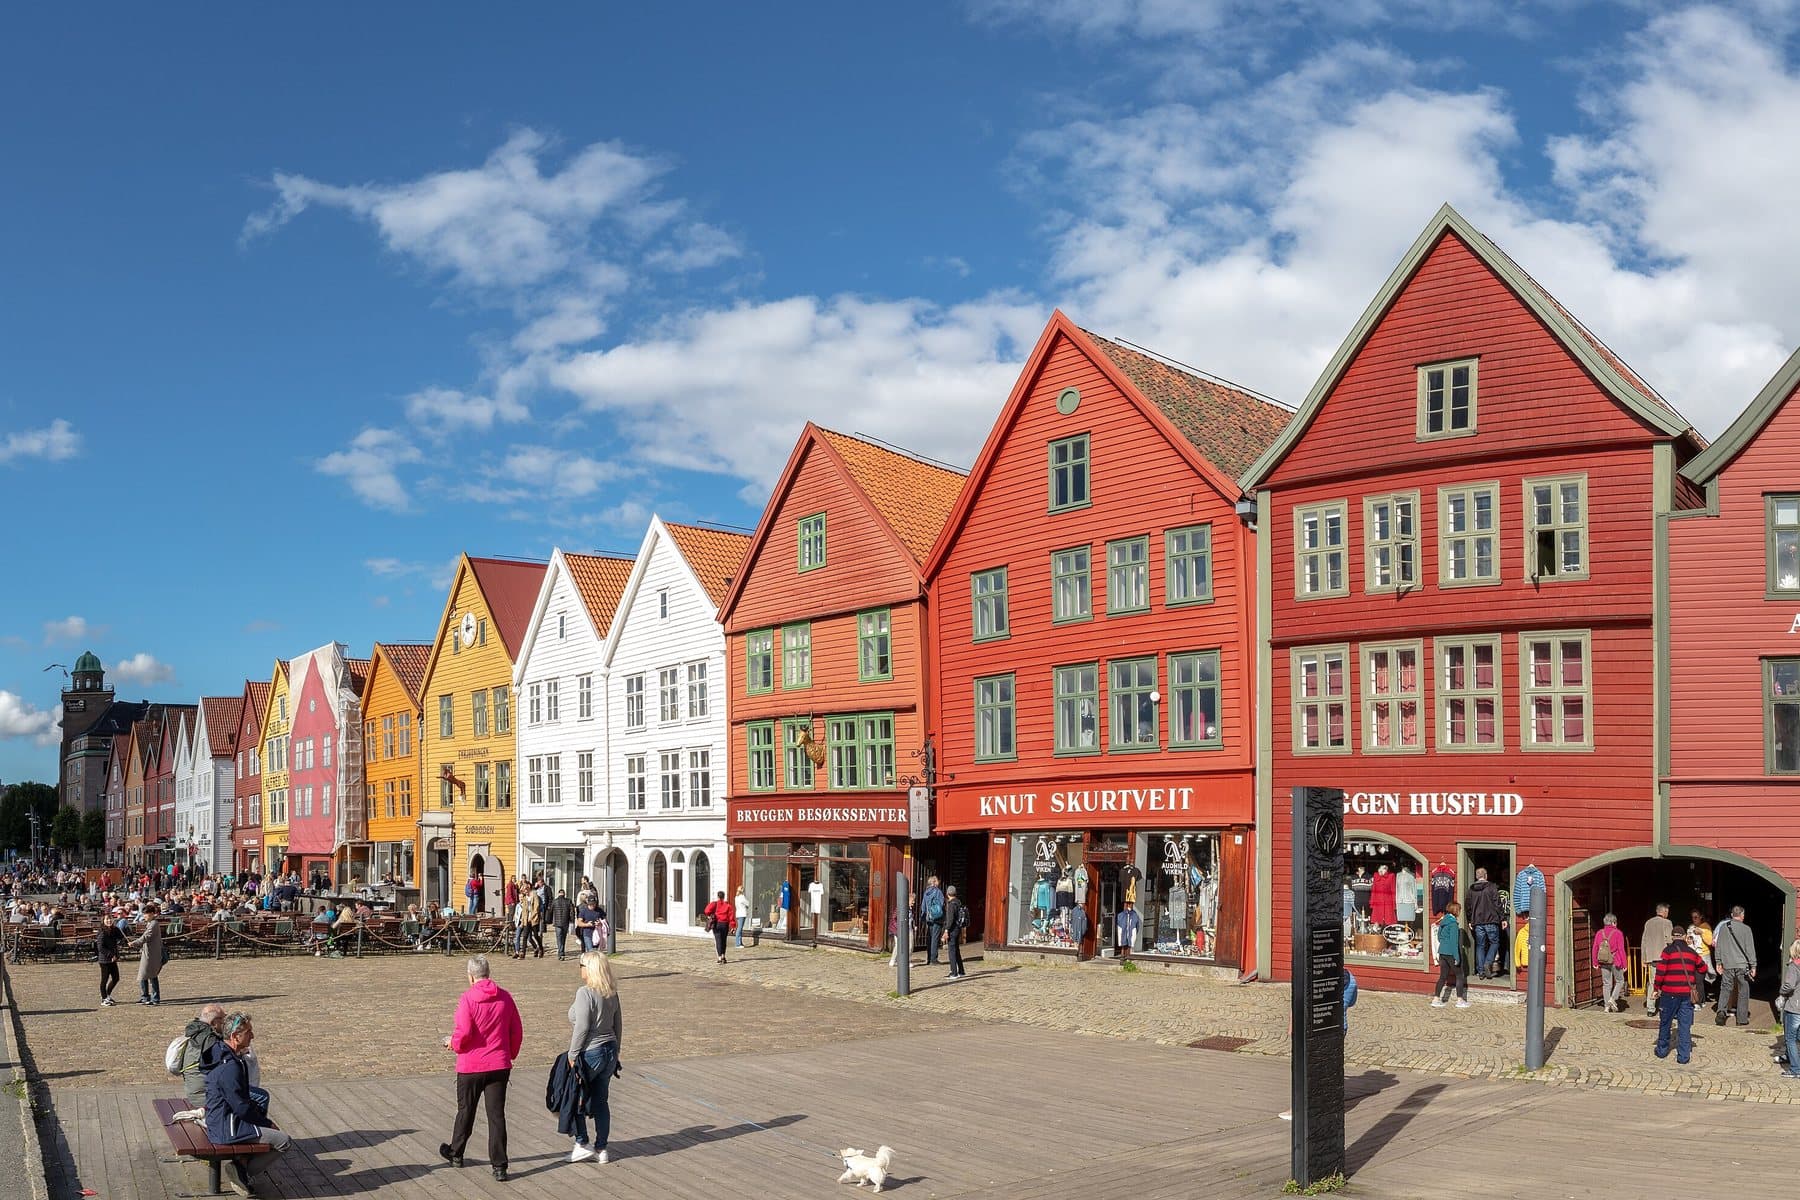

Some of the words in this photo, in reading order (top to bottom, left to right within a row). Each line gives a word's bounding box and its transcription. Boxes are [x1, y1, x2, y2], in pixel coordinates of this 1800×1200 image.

[979, 794, 1037, 816] KNUT
[1050, 788, 1193, 813] SKURTVEIT
[1409, 792, 1524, 816] HUSFLID
[737, 809, 793, 822] BRYGGEN
[797, 808, 907, 822] BESØKSSENTER
